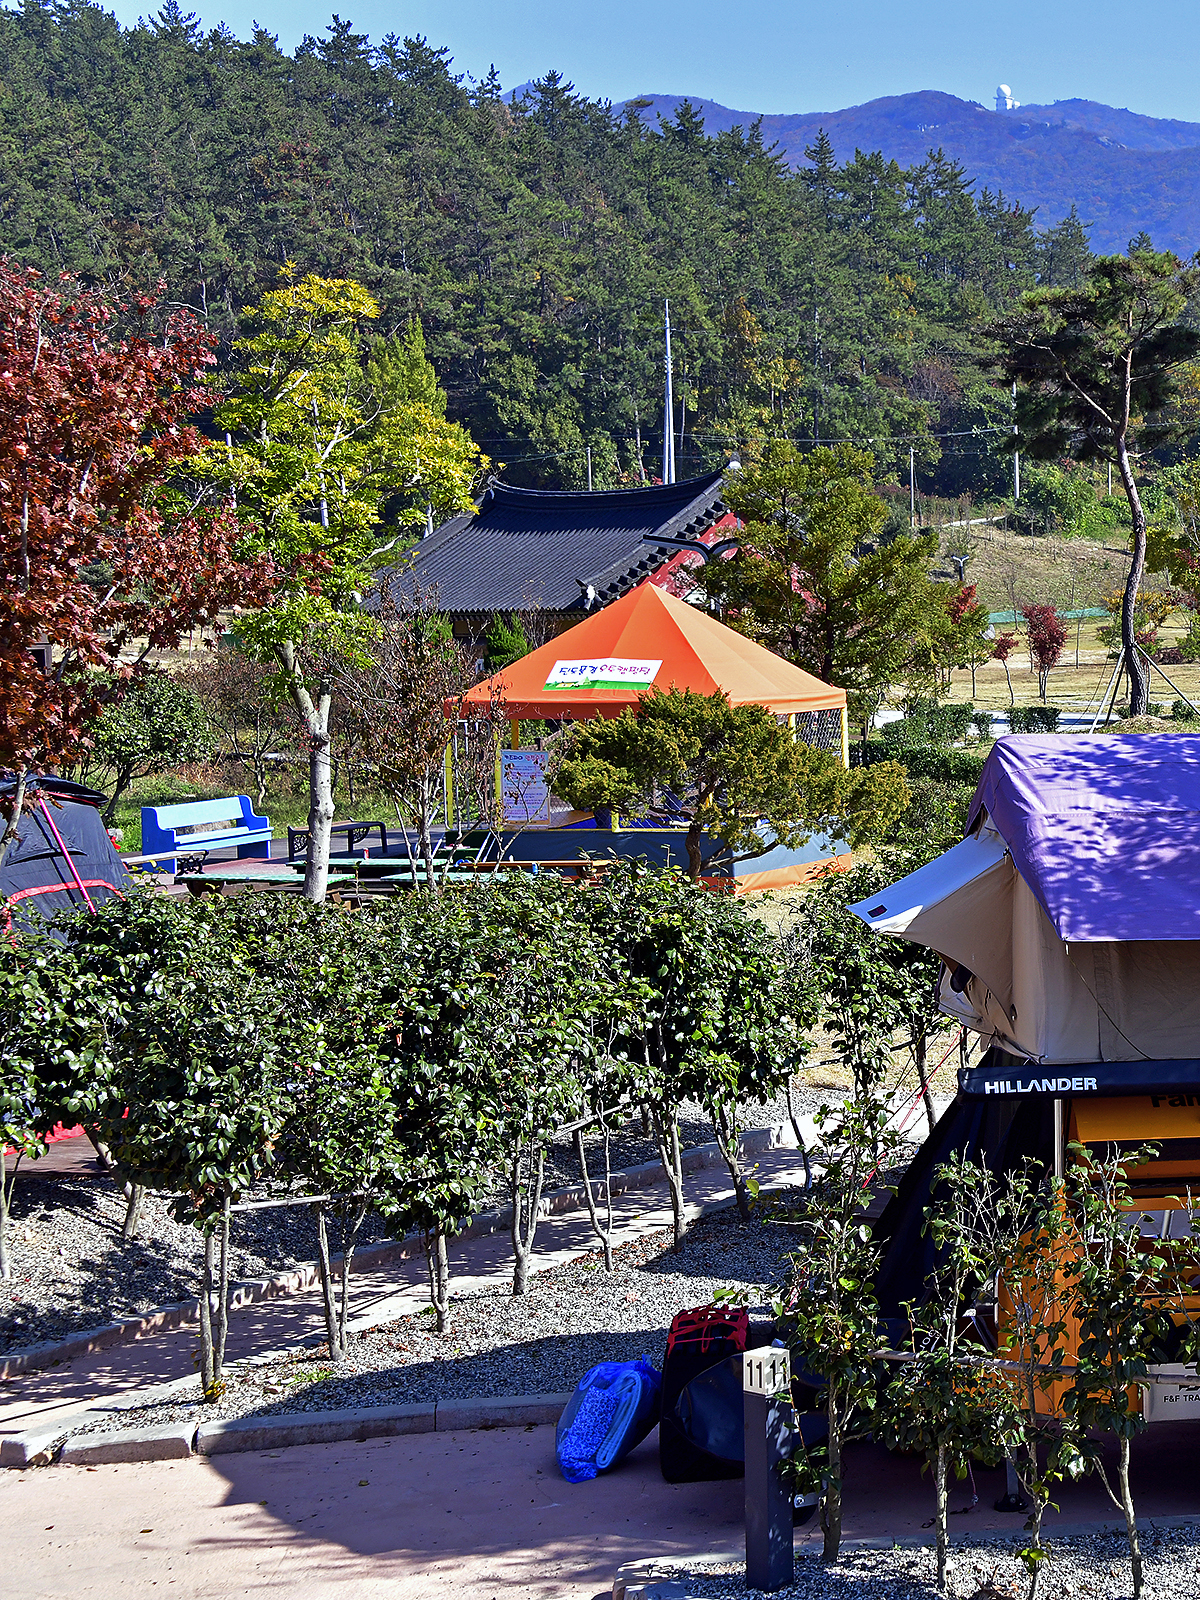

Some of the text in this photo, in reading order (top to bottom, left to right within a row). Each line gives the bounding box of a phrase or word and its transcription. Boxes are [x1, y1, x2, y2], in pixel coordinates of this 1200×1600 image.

[985, 1077, 1098, 1094] HILLANDER
[746, 1359, 762, 1389] 11
[770, 1356, 787, 1388] 11
[1163, 1395, 1180, 1403] F&F
